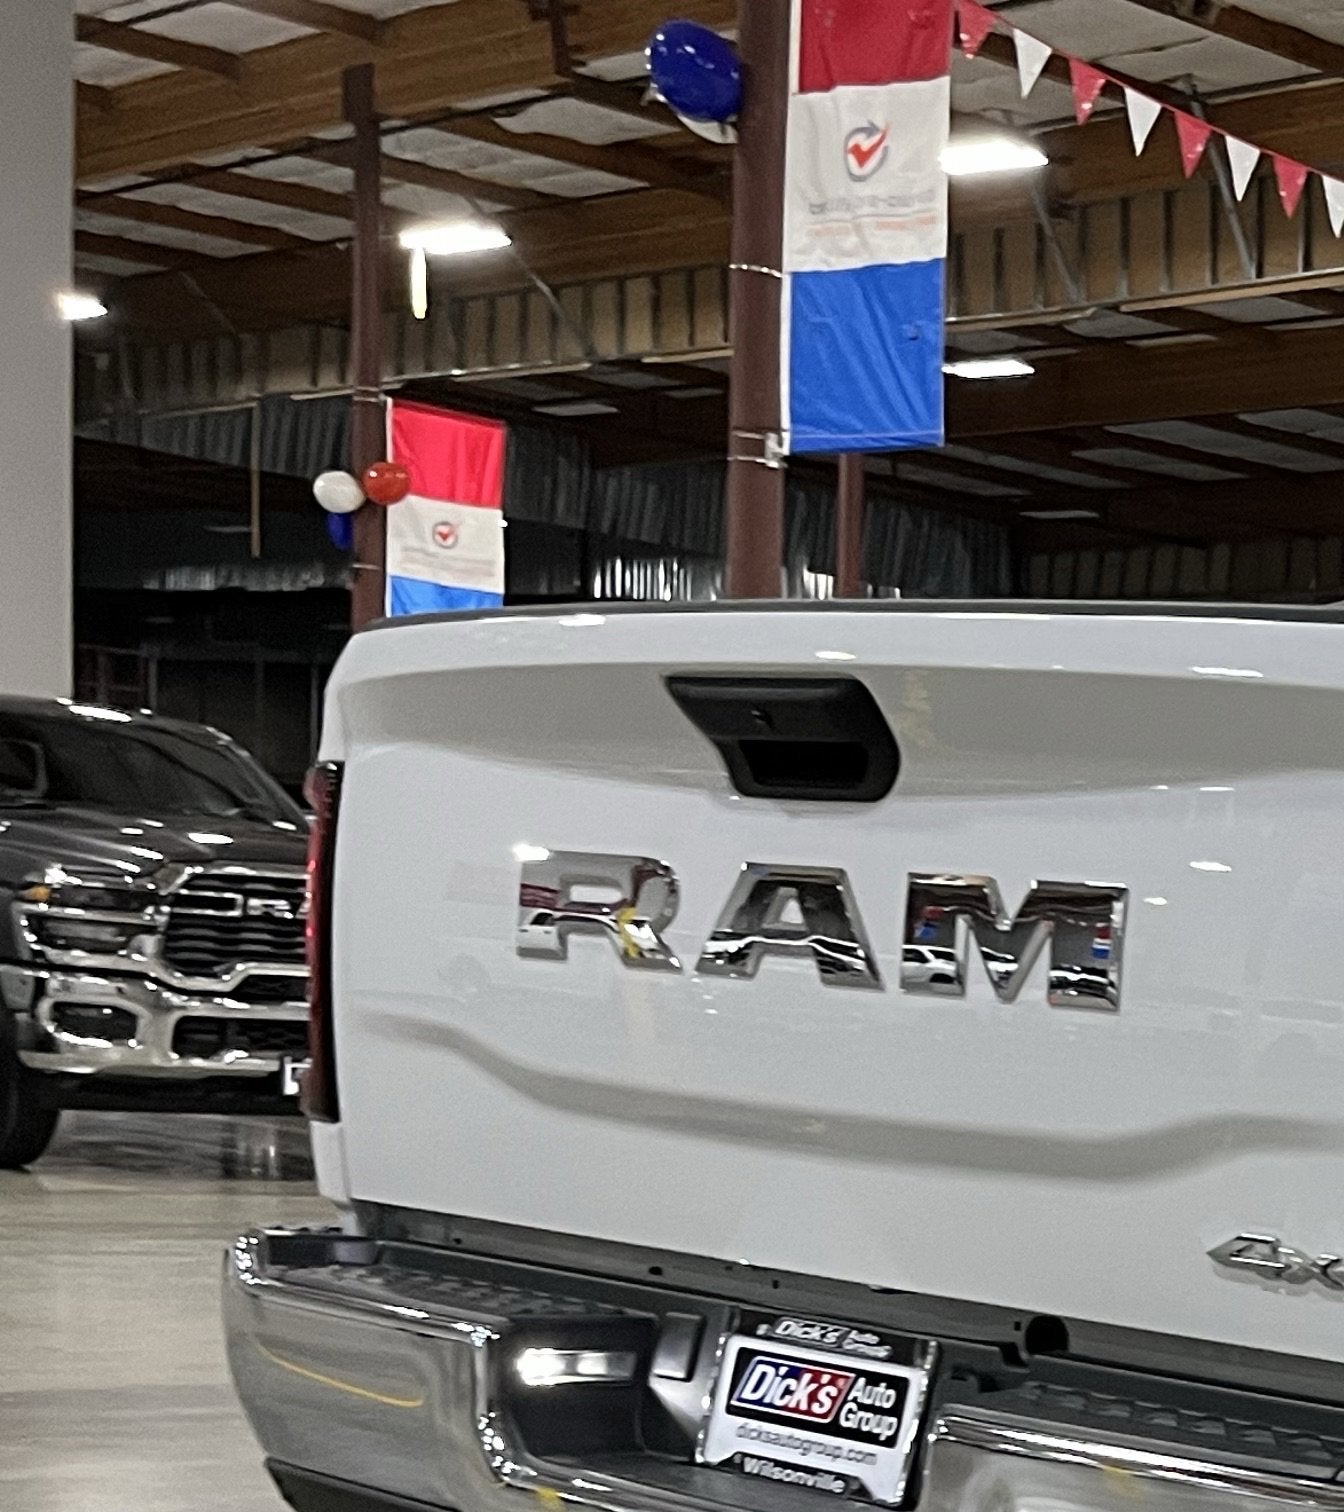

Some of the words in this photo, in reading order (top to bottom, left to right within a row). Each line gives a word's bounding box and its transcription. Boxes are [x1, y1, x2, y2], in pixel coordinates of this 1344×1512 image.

[515, 846, 1129, 1014] RAM
[774, 1319, 840, 1344] Dick's
[739, 1363, 839, 1415] Dick's
[848, 1377, 897, 1409] Auto
[839, 1402, 899, 1441] Group
[735, 1422, 878, 1466] dicksautogroup.com
[742, 1456, 847, 1494] Wilsonville
